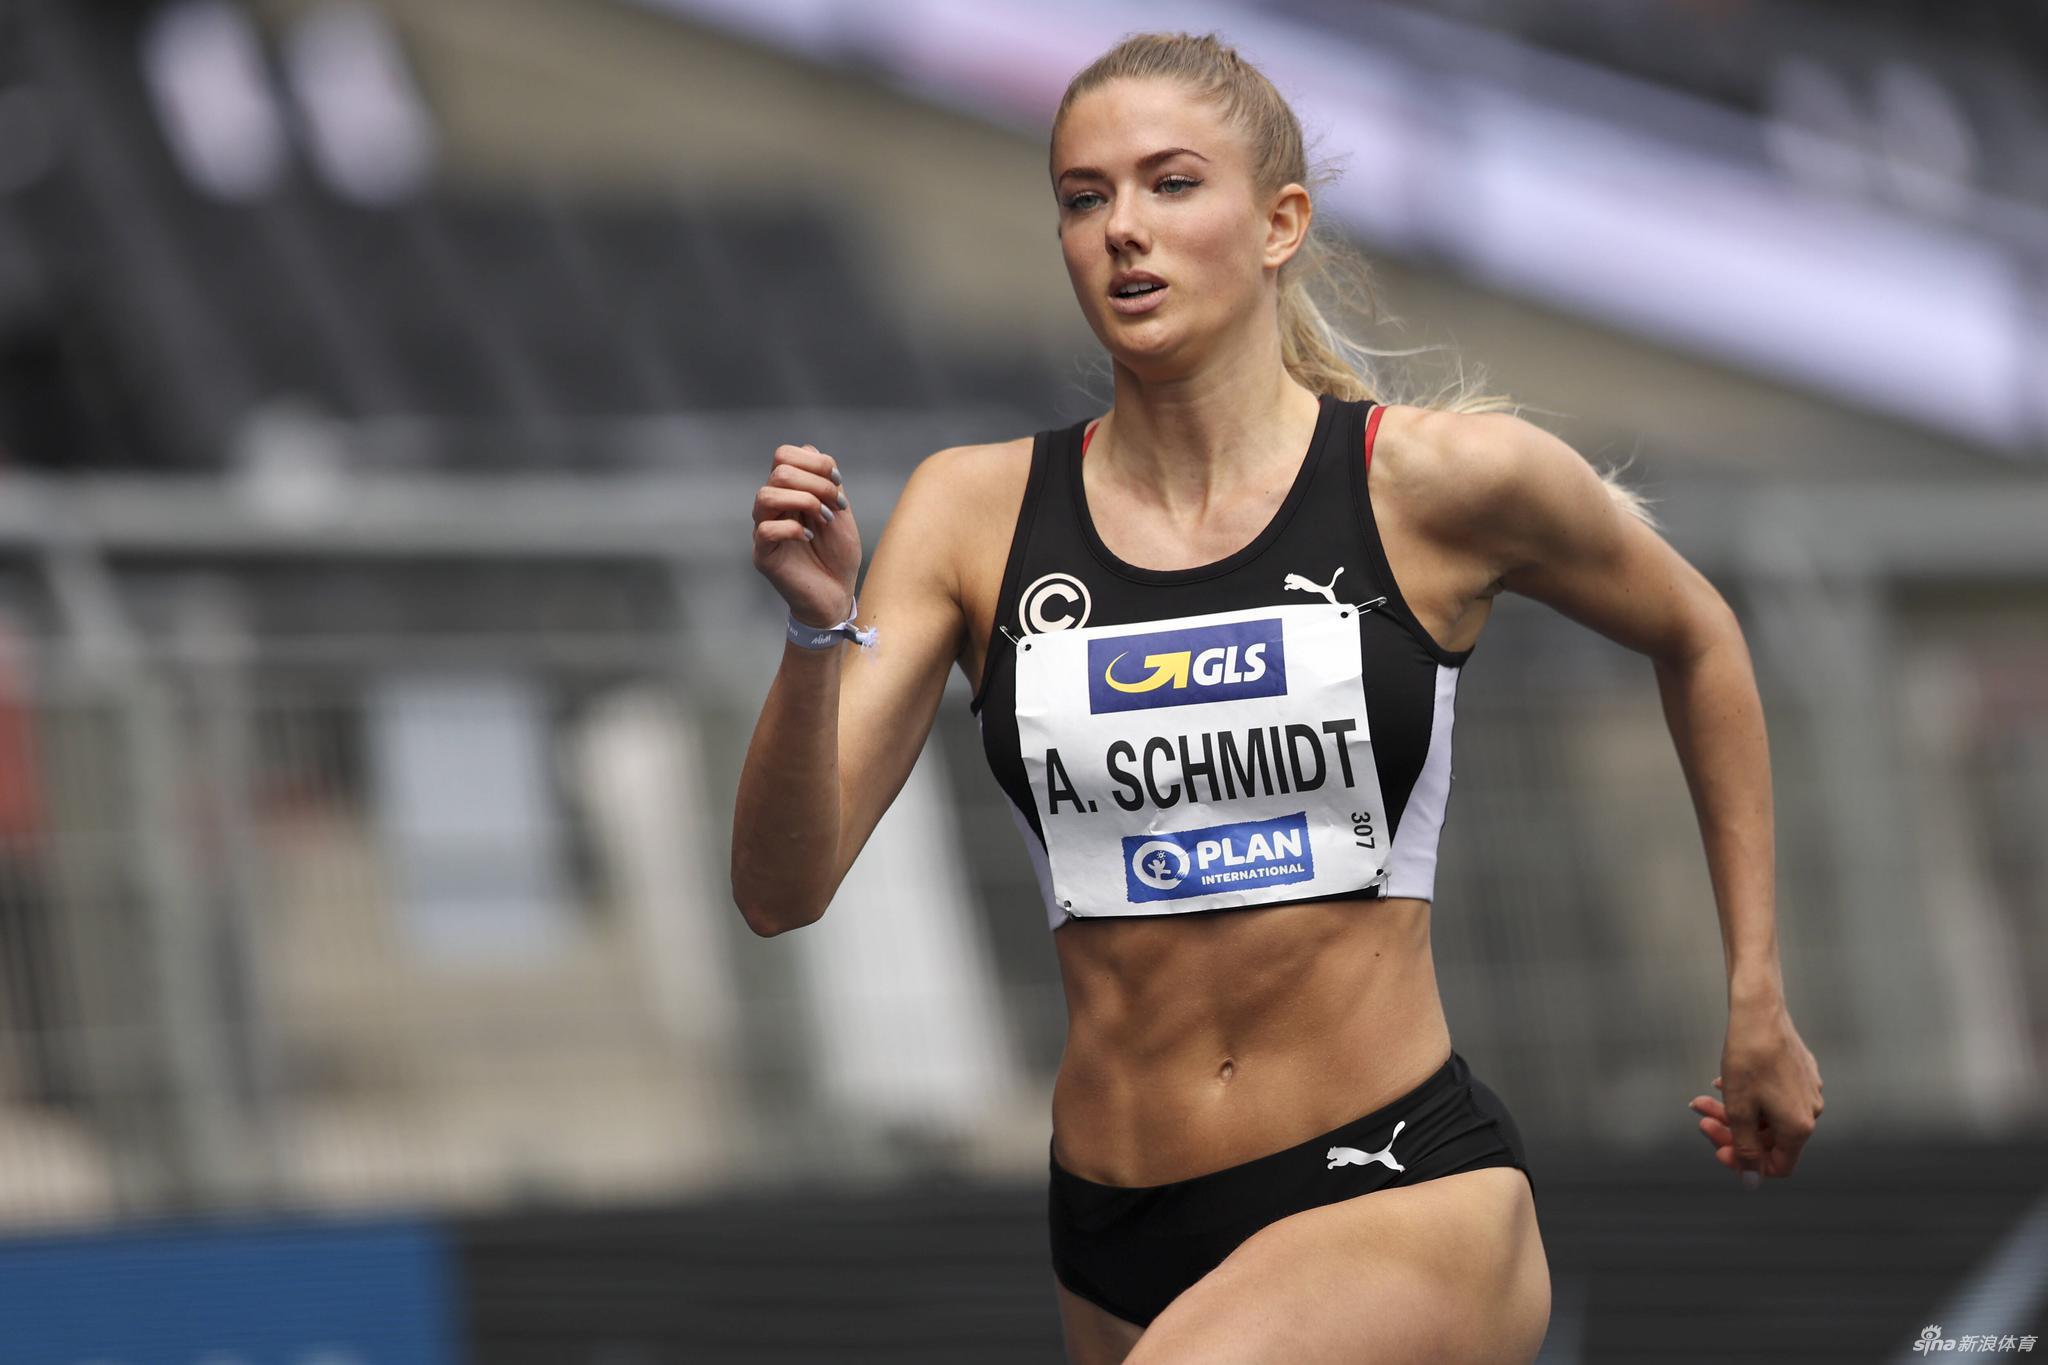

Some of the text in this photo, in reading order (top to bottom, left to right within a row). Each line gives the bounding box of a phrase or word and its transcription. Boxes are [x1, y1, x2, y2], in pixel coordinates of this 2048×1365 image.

[1192, 642, 1267, 687] GLS
[1045, 718, 1358, 815] A. SCHMIDT
[1198, 828, 1303, 870] PLAN
[1351, 811, 1375, 851] 307
[1201, 863, 1305, 886] INTERNATIONAL
